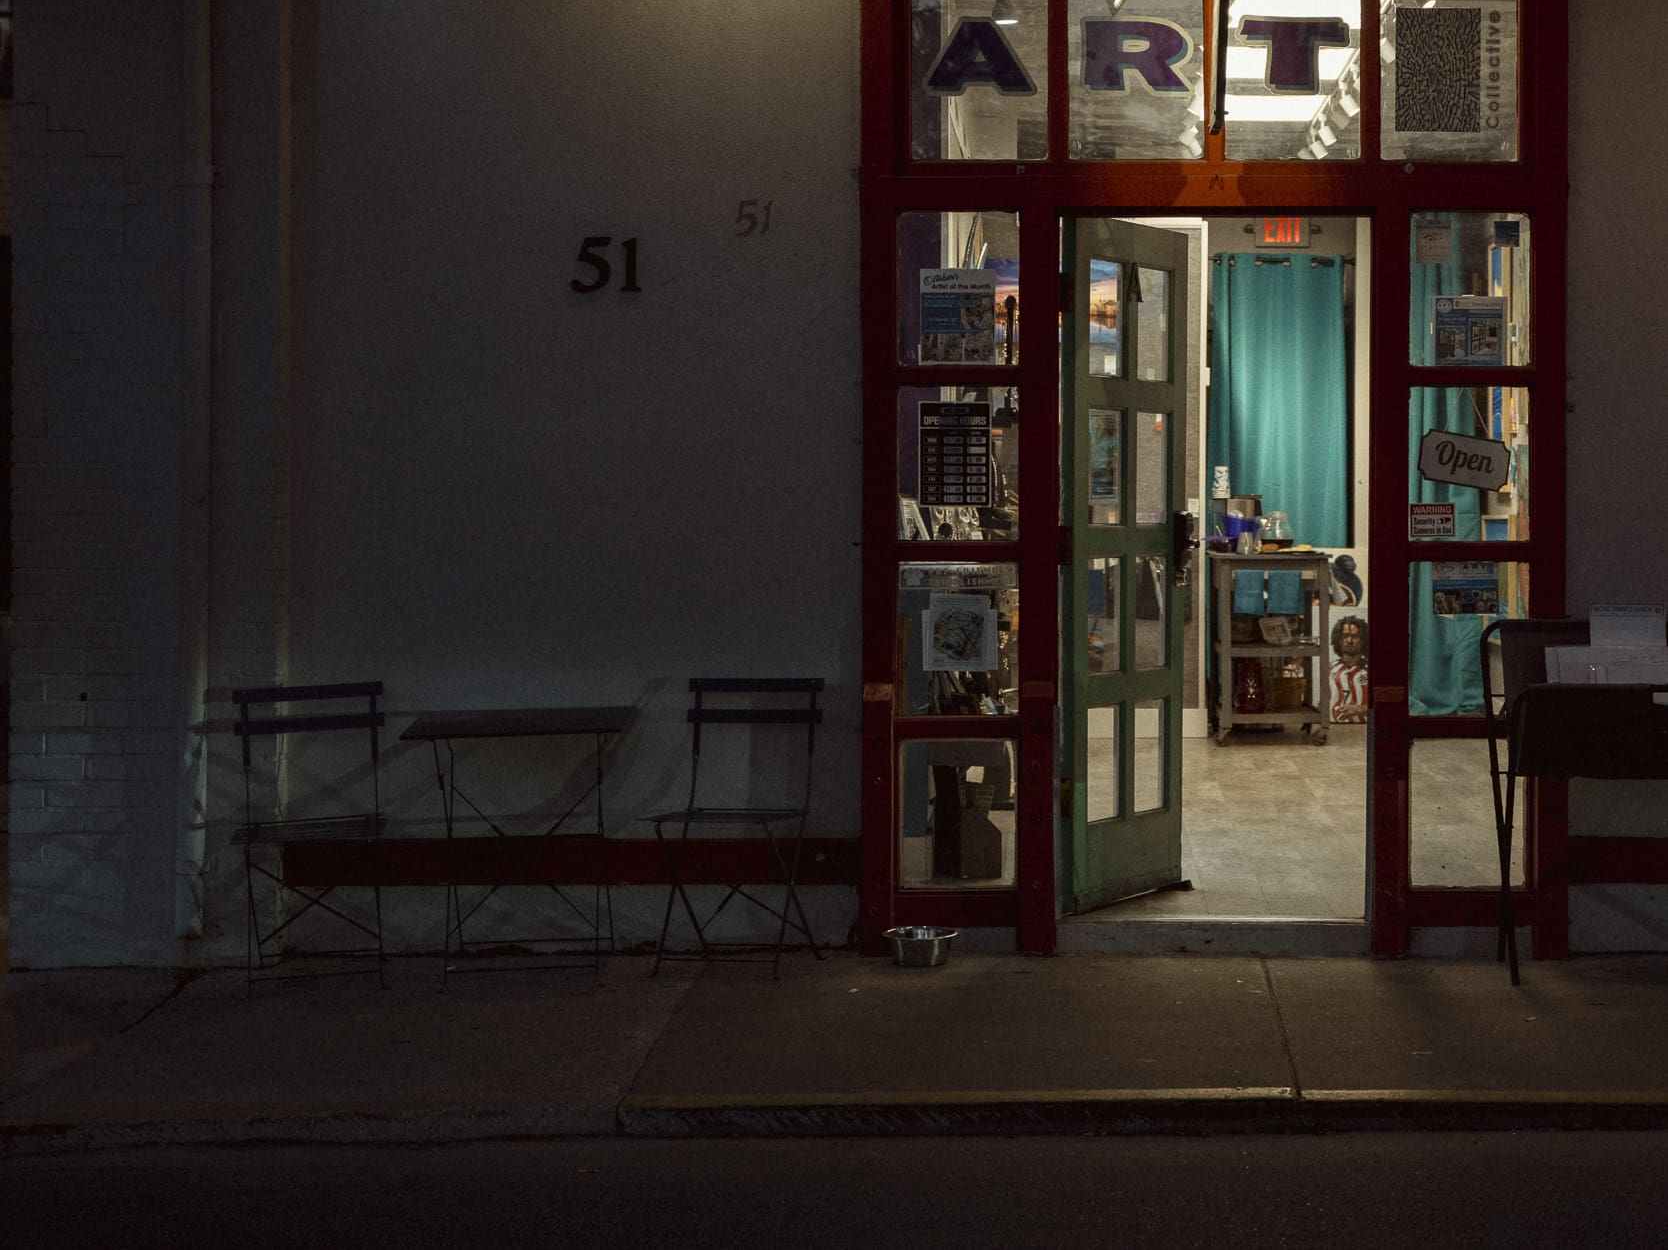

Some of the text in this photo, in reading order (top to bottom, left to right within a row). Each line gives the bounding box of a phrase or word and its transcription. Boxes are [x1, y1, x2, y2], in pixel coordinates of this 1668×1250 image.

[922, 16, 1351, 96] ART
[1486, 11, 1501, 129] Collective
[1263, 216, 1301, 244] EXIT
[570, 236, 642, 294] 51
[960, 415, 987, 426] HOURS
[1435, 440, 1494, 475] Open
[1412, 505, 1453, 514] WARNING
[1413, 517, 1435, 526] Security
[1413, 526, 1435, 534] Cameras
